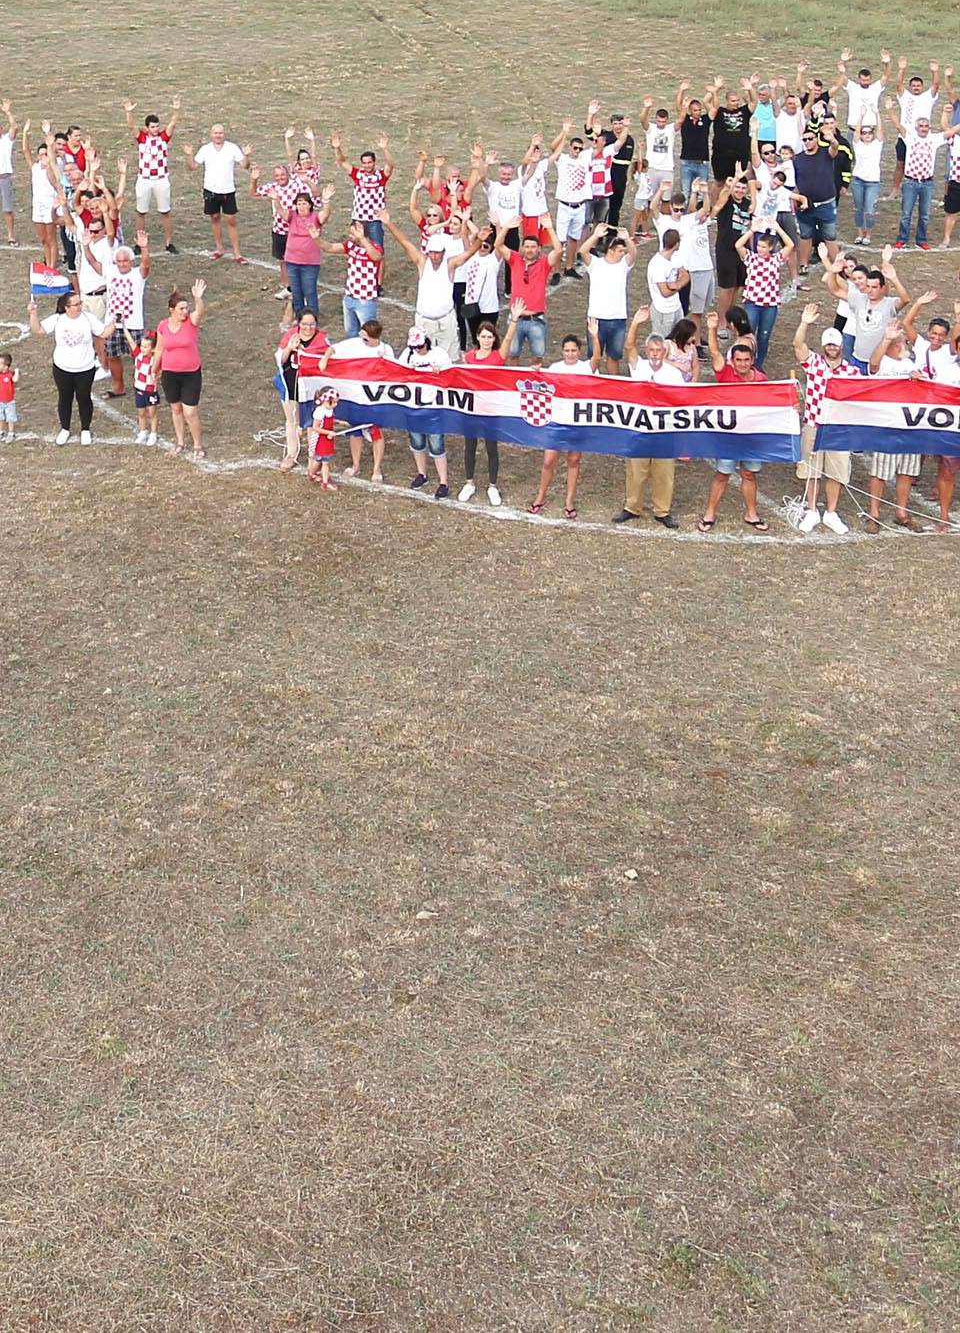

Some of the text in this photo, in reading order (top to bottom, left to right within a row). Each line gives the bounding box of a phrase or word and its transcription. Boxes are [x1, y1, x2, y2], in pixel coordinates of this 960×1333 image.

[361, 384, 737, 430] VOLIM HRVATSKU
[900, 406, 960, 430] VO
